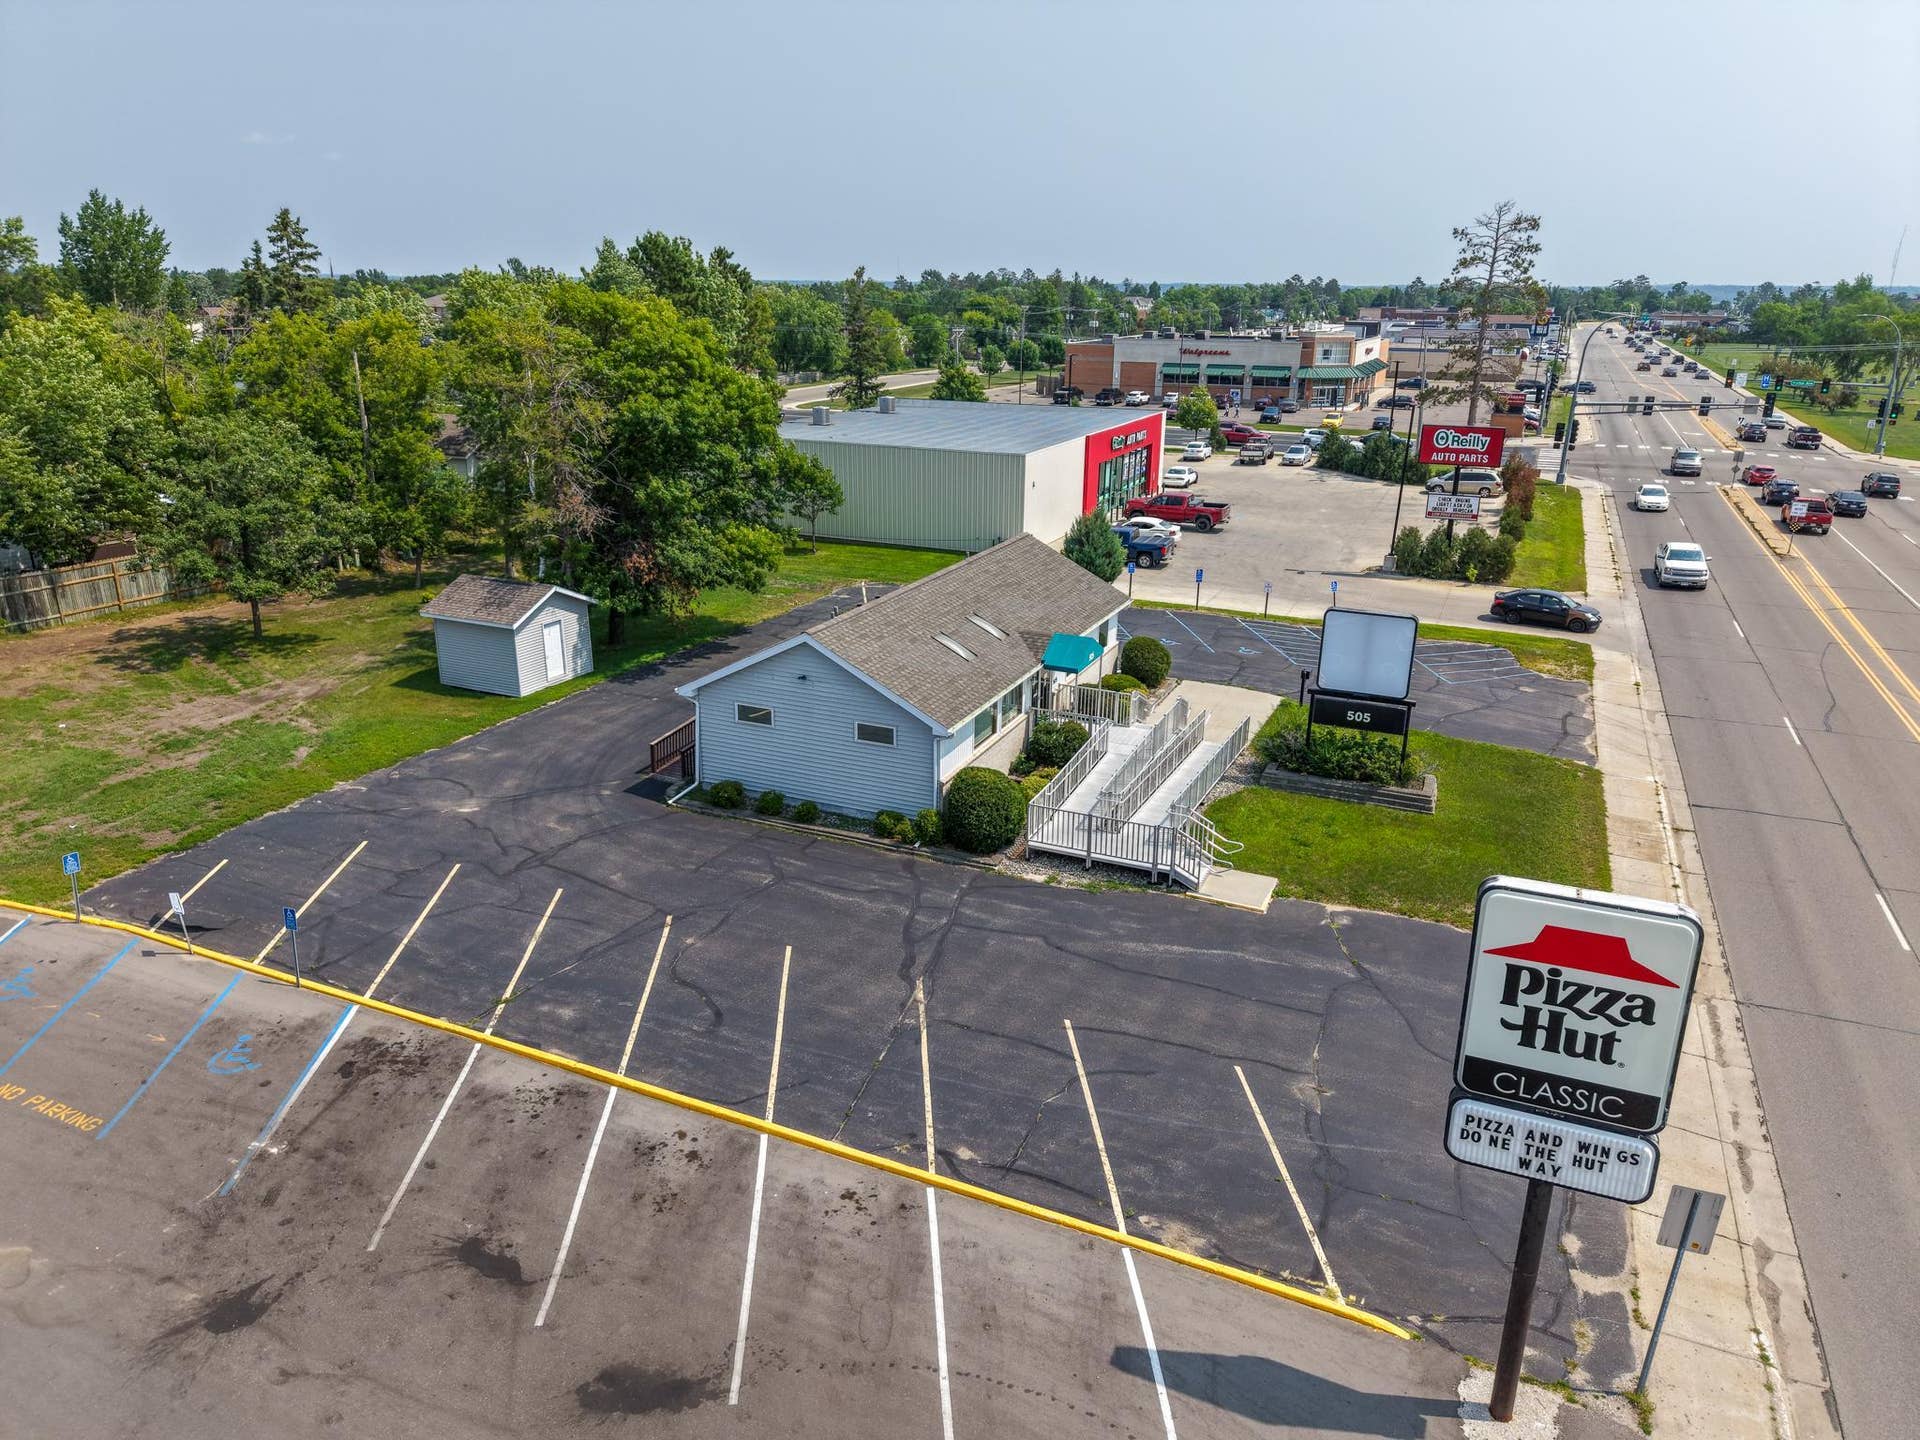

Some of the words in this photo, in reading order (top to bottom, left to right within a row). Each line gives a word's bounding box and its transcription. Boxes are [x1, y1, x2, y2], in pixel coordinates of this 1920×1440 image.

[1434, 430, 1490, 450] O'Reilly
[1431, 452, 1456, 461] AUTO
[1458, 454, 1489, 463] PARTS
[1346, 711, 1371, 723] 505
[1500, 962, 1656, 1027] Pizza
[1500, 1004, 1622, 1066] Hut
[0, 1084, 26, 1100] NO
[21, 1095, 104, 1131] PARKING
[1493, 1072, 1625, 1118] CLASSIC
[1465, 1114, 1514, 1137] PIZZA
[1524, 1130, 1563, 1148] AND
[1518, 1157, 1562, 1177] WAY
[1524, 1144, 1556, 1161] THE
[1572, 1156, 1607, 1173] HUT
